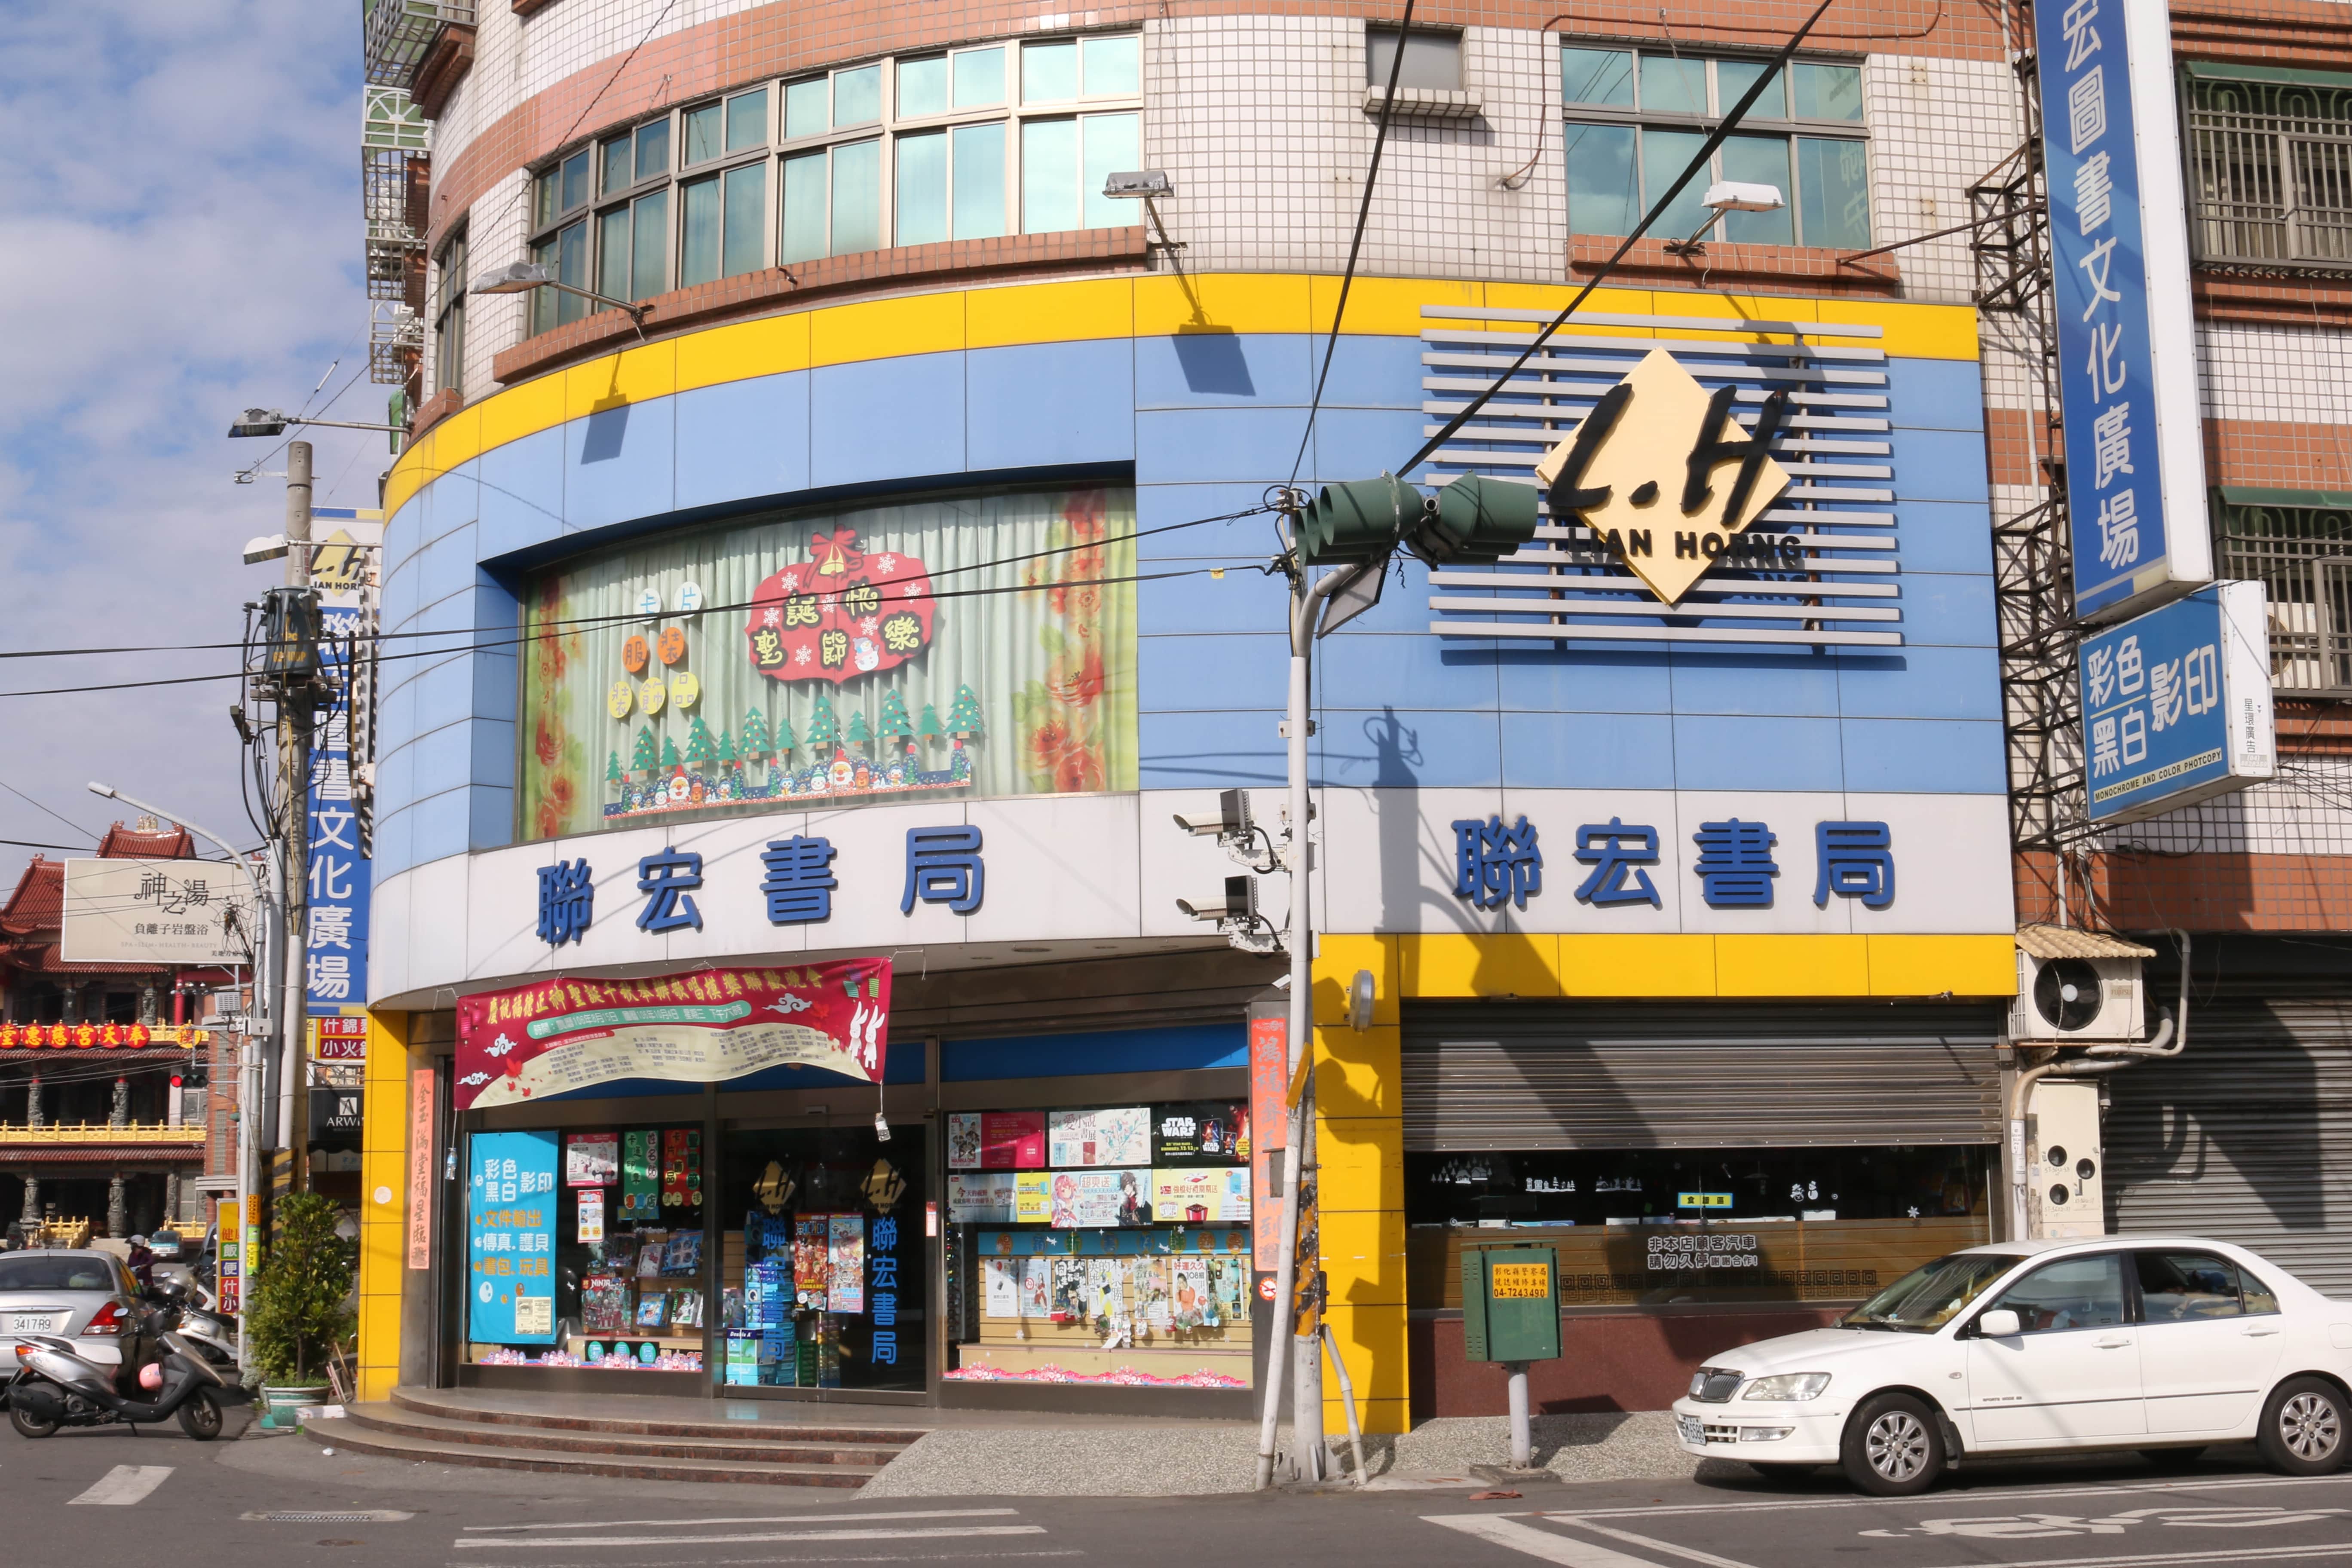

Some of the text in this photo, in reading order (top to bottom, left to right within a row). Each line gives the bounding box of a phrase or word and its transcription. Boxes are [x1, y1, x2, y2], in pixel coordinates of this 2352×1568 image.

[1568, 527, 1801, 560] LIAN HORNG
[626, 630, 682, 664] 服裝
[2088, 635, 2144, 707] 彩色
[612, 674, 693, 715] 裝飾品
[2150, 644, 2218, 732] 影印
[2093, 707, 2147, 778] 黑白
[2095, 750, 2221, 801] MONOCHROME AND COLOR PHOTCOPY
[1451, 815, 1895, 906] 聯宏書局
[536, 825, 984, 945] 聯宏書局
[135, 923, 208, 935] 負離子岩盤浴
[1161, 1117, 1196, 1127] STAR
[1161, 1127, 1196, 1137] WARS
[485, 1158, 517, 1180] 彩色
[485, 1181, 516, 1202] 黑白
[520, 1172, 552, 1193] 影印
[484, 1209, 542, 1228] 文件輸出
[1648, 1234, 1757, 1252] 非本店顧客汽車
[1174, 1262, 1205, 1271] 好運久久
[1494, 1267, 1547, 1276] 彰化縣警察局
[871, 1217, 897, 1365] 聯宏書局
[1494, 1288, 1545, 1298] 04-7243490
